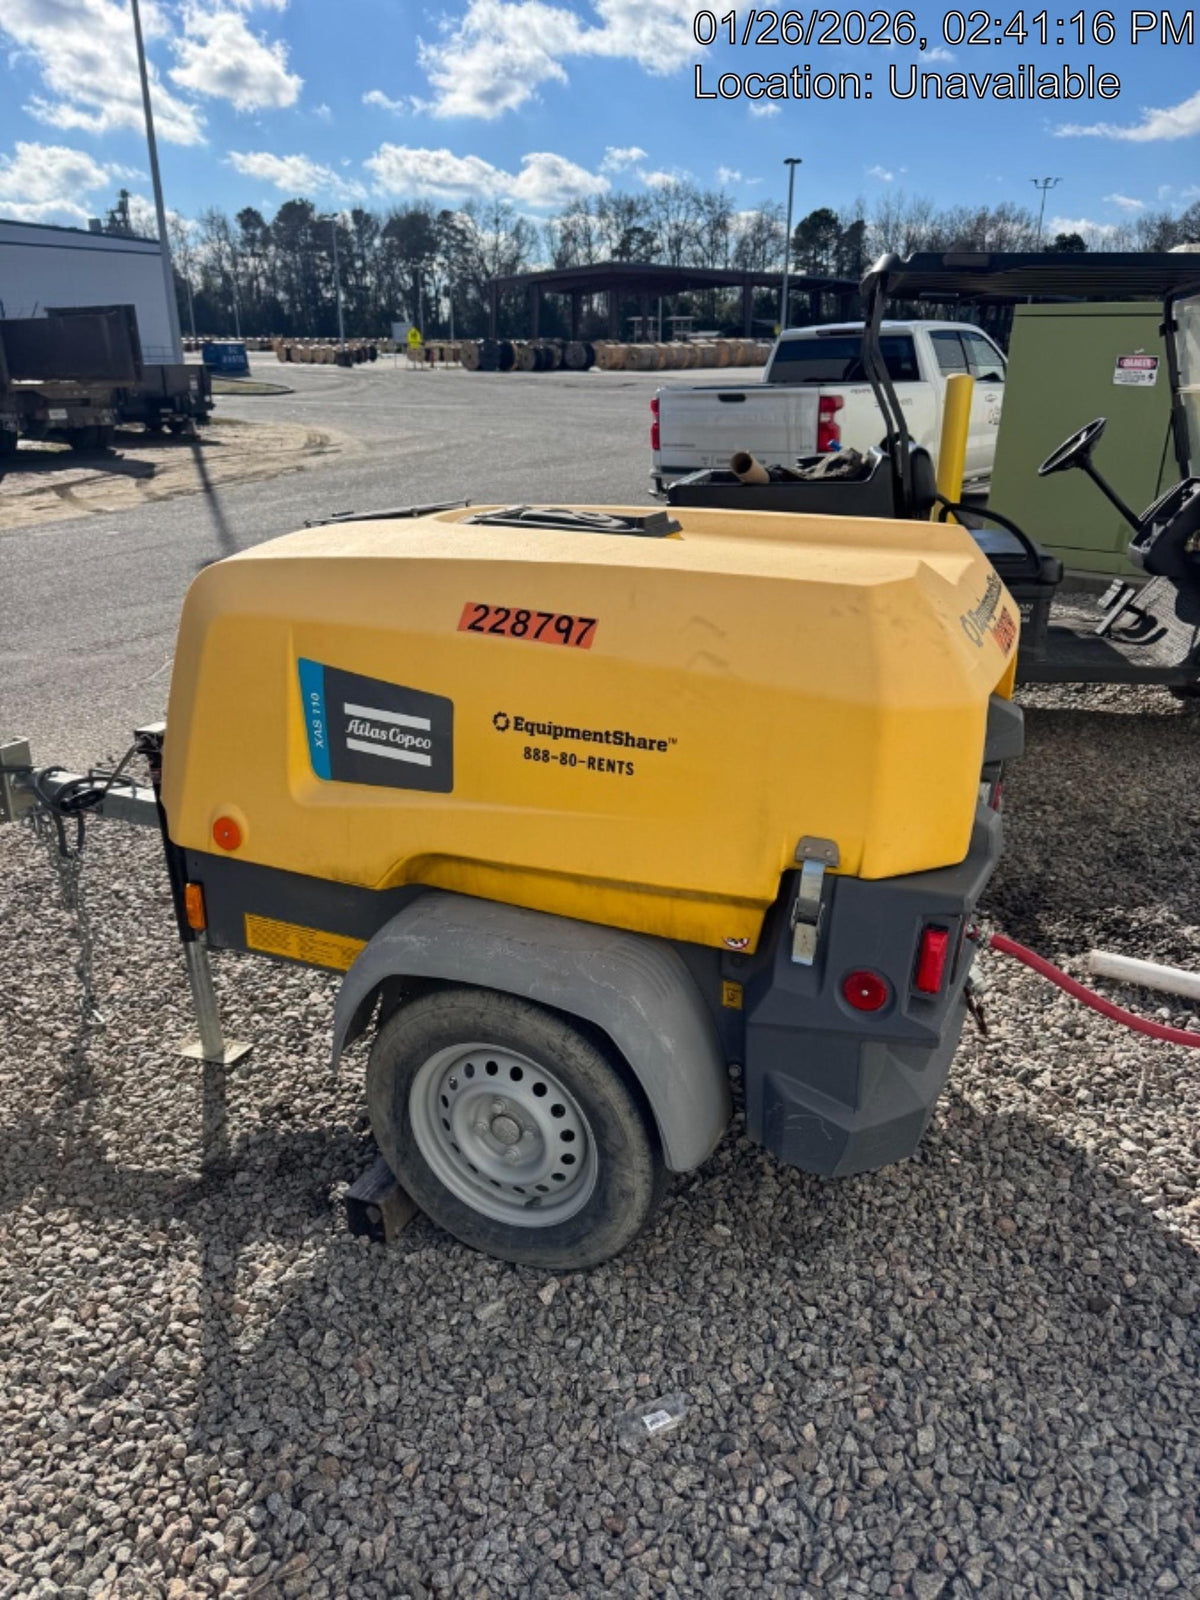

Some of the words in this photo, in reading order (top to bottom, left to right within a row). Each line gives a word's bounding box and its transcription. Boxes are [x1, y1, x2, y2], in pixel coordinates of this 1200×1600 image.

[467, 604, 597, 646] 228797
[310, 692, 320, 714] 110
[313, 719, 324, 748] XAS
[345, 719, 388, 740] Atlas
[388, 727, 432, 749] Copco
[523, 746, 635, 776] 888-80-RENTS
